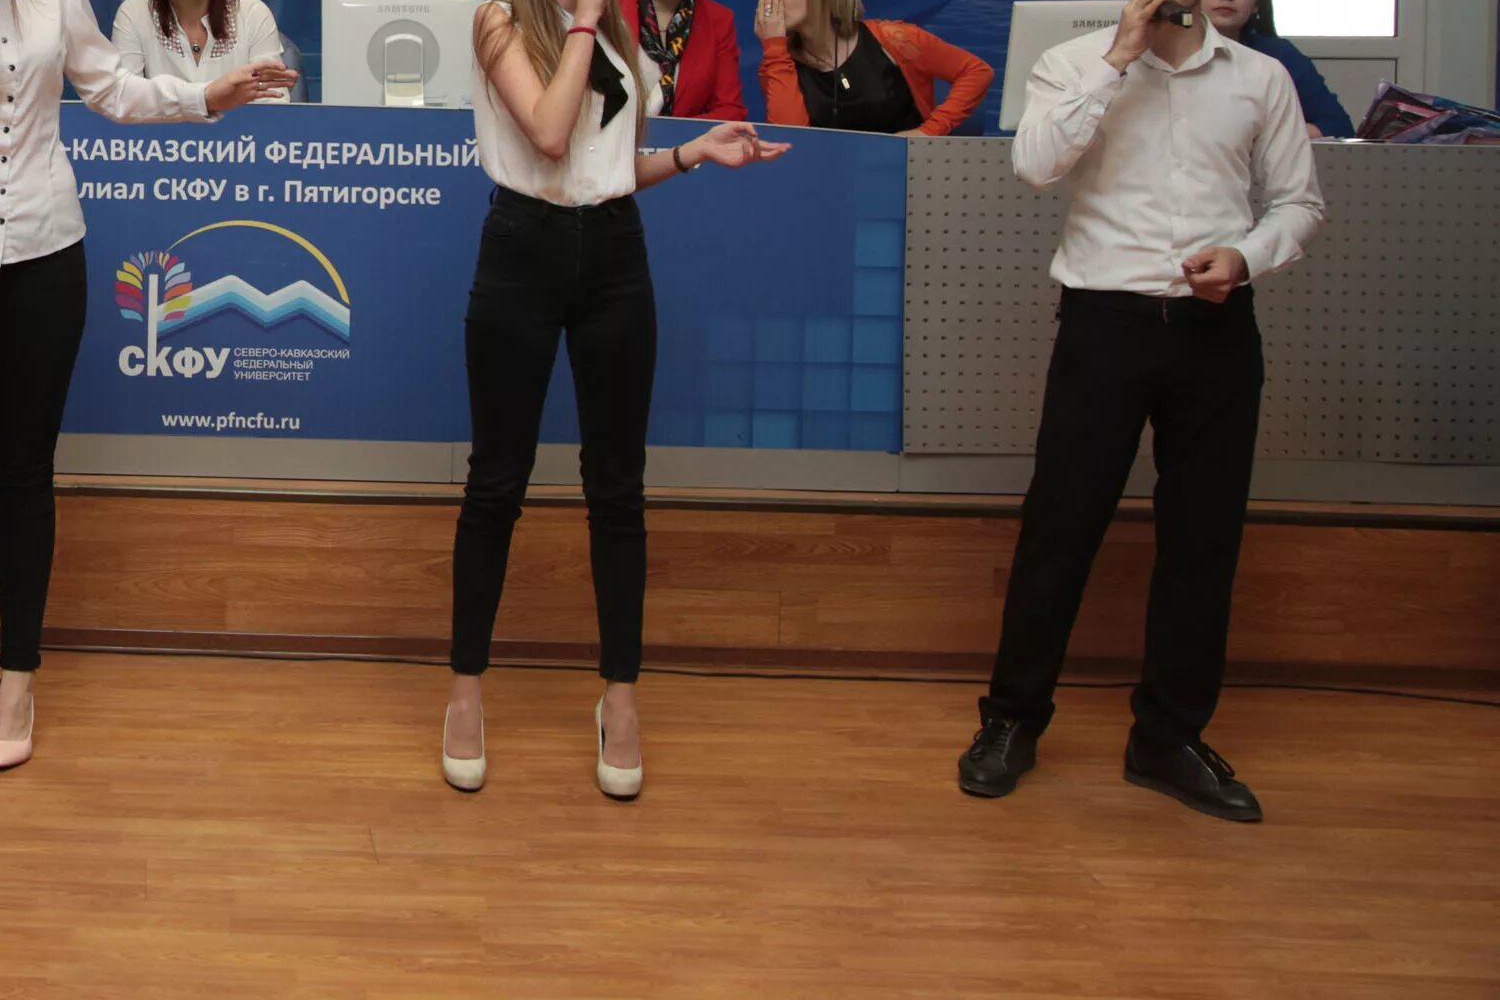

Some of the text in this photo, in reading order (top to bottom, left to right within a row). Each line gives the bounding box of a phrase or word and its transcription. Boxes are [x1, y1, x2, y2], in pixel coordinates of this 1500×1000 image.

[59, 134, 257, 164] -КАВКАЗСКИЙ
[264, 137, 480, 168] ФЕДЕРАЛЬНЫЙ
[78, 178, 442, 210] лиал СКФУ в г. Пятигорске
[234, 347, 350, 360] СЕВЕРО-КАВКАЗСКИЙ
[233, 359, 314, 370] ФЕДЕРАЛЬНЫЙ
[234, 370, 311, 382] УНИВЕРСИТЕТ
[162, 411, 301, 432] www.pfncfu.ru
